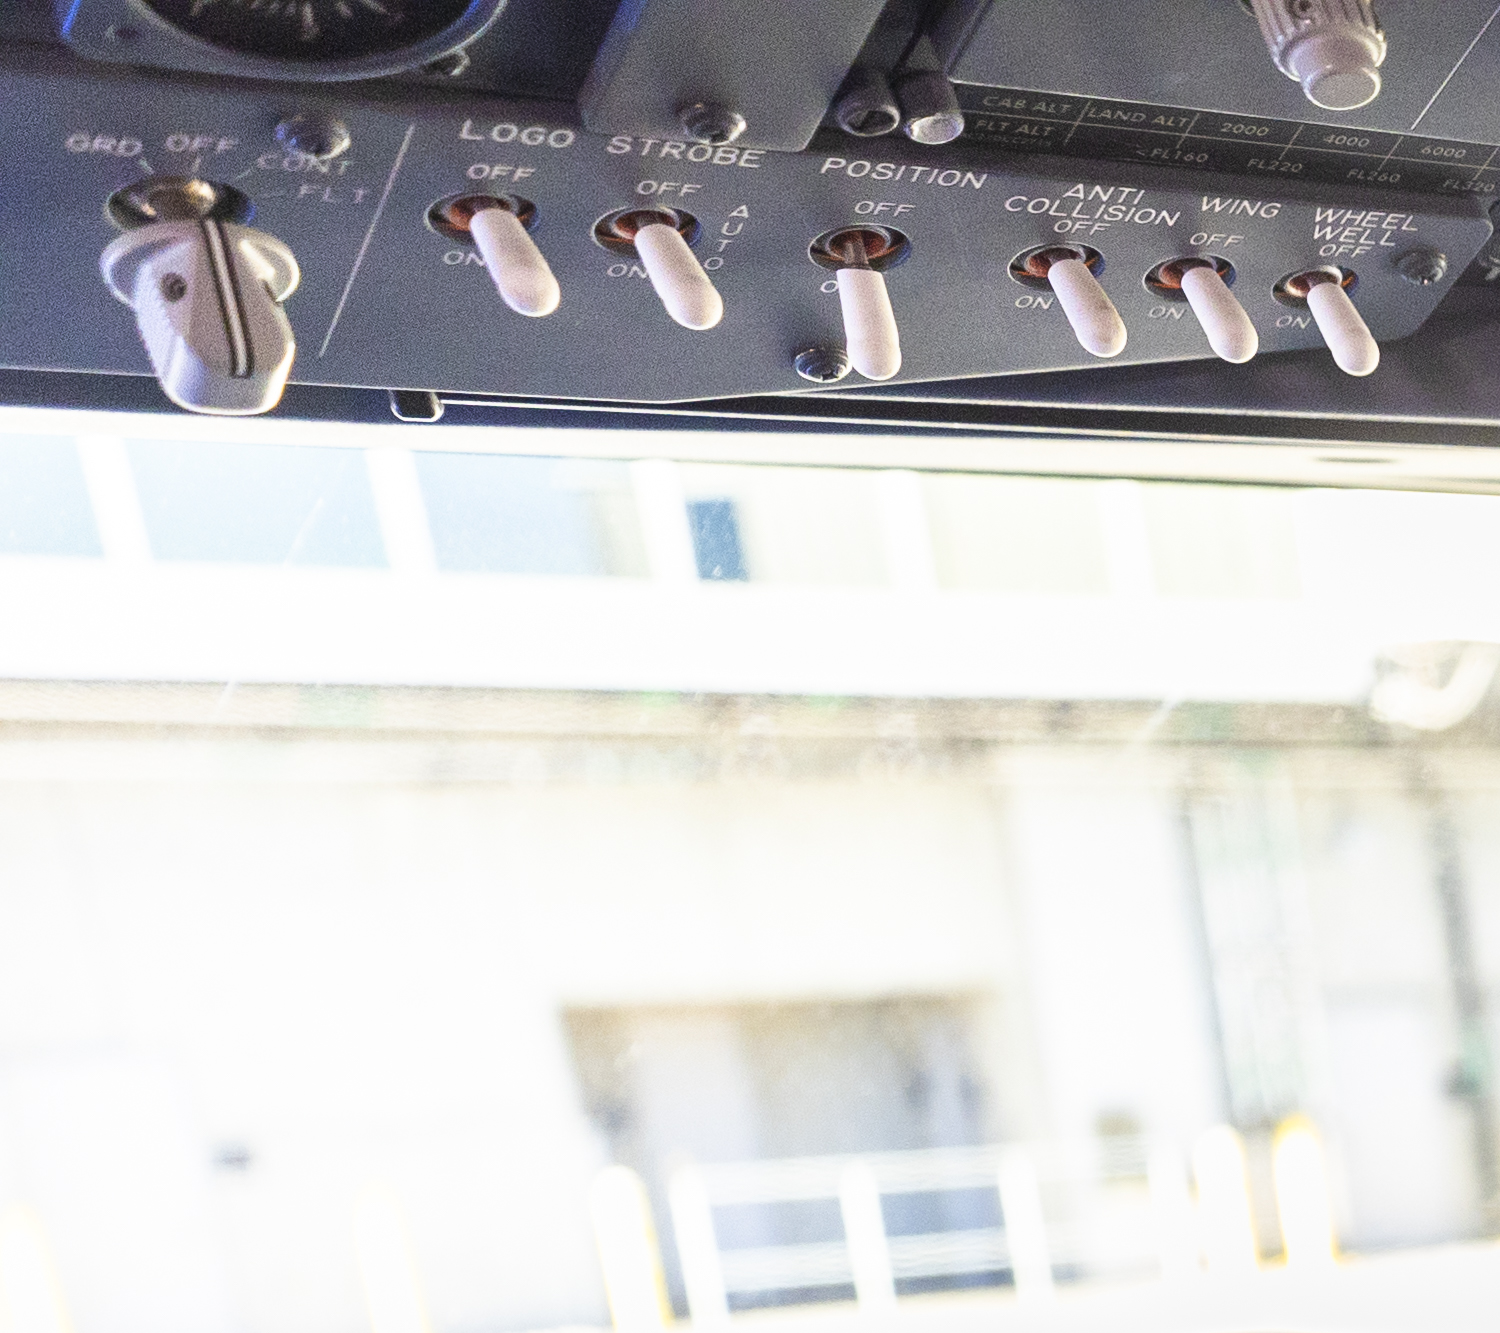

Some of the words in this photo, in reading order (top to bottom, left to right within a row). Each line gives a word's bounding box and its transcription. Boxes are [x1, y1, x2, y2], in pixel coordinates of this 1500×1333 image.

[1087, 105, 1146, 124] LAND
[1152, 113, 1190, 128] ALT
[458, 118, 576, 149] LOGO
[1015, 123, 1055, 137] ALT
[1220, 122, 1269, 137] 2000
[64, 132, 144, 157] GRD
[164, 132, 240, 153] OFF
[1323, 134, 1370, 149] 4000
[606, 135, 766, 169] STROBE
[1421, 145, 1466, 160] 6000
[466, 163, 537, 182] OFF
[819, 156, 988, 191] POSITION
[1247, 157, 1303, 174] FL220
[635, 180, 703, 197] OFF
[1062, 183, 1146, 206] ANTI
[854, 200, 916, 218] OFF
[1003, 195, 1182, 228] COLLISION
[1200, 195, 1283, 219] WING
[1052, 218, 1111, 237] OFF
[1314, 206, 1419, 232] WHEEL
[1189, 231, 1245, 248] OFF
[1312, 224, 1397, 248] WELL
[443, 250, 486, 267] ON
[1318, 243, 1373, 259] OFF
[606, 263, 648, 279] ON
[1014, 294, 1053, 311] ON
[1149, 304, 1185, 320] ON
[1275, 315, 1312, 330] ON
